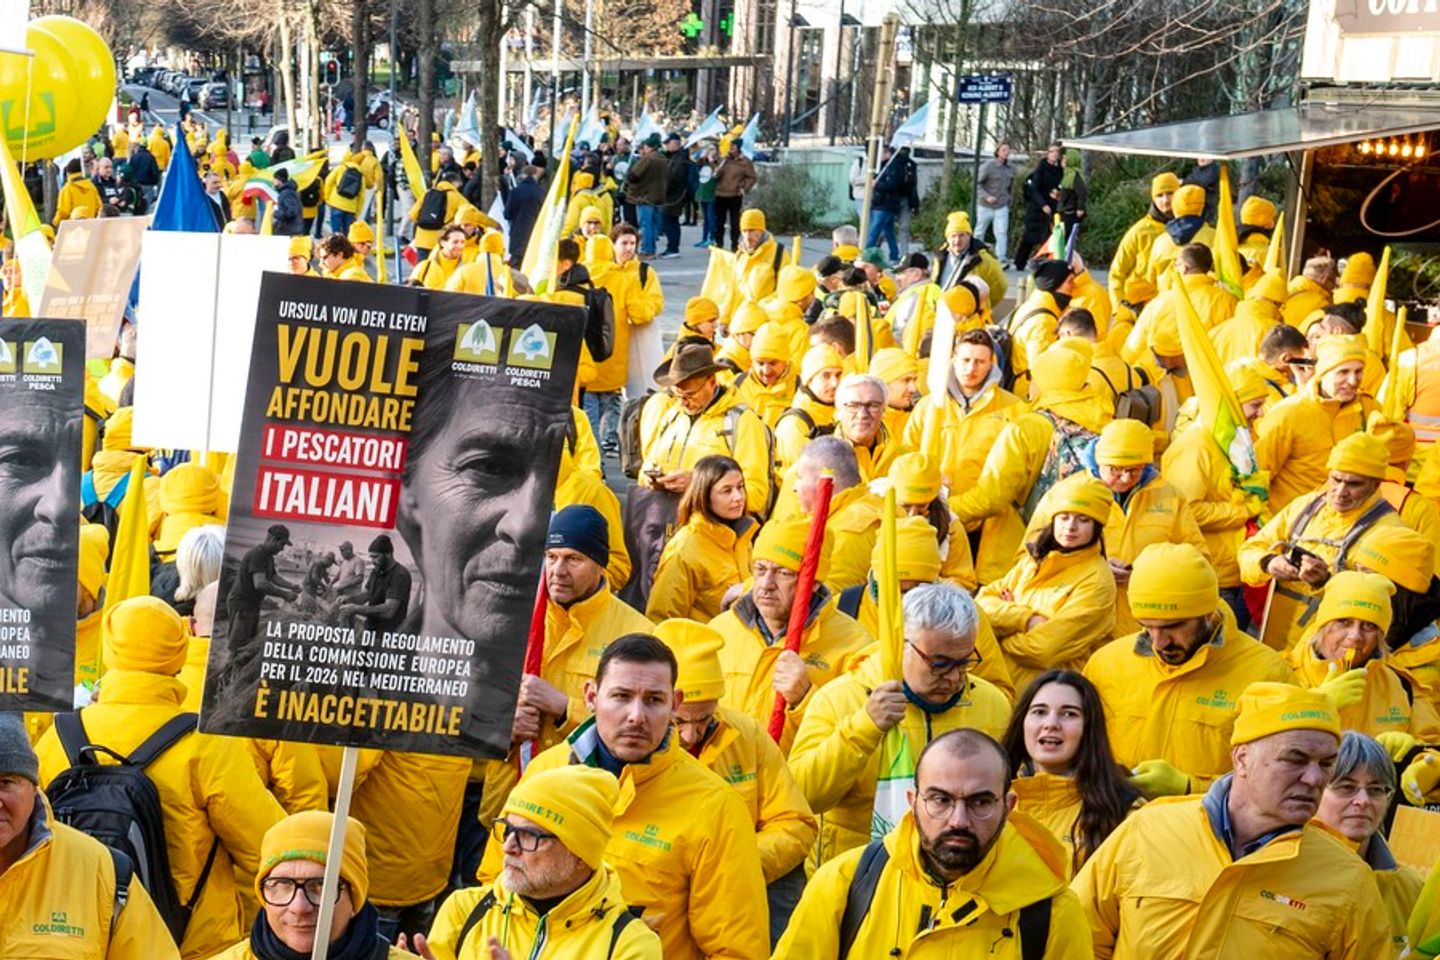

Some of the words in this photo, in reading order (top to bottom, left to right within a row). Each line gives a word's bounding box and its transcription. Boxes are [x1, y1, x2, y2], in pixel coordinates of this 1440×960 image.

[279, 300, 329, 323] URSULA
[331, 306, 358, 326] VON
[361, 309, 386, 329] DER
[389, 312, 428, 333] LEYEN
[276, 323, 426, 398] VUOLE
[451, 361, 498, 375] COLDIRETTI
[505, 366, 551, 380] COLDIRETTI
[22, 374, 62, 384] COLDIRETTI
[28, 382, 56, 391] PESCA
[510, 377, 541, 389] PESCA
[265, 385, 416, 431] AFFONDARE
[265, 428, 276, 456] I
[281, 429, 403, 470] PESCATORI
[259, 471, 393, 523] ITALIANI
[266, 621, 282, 638] LA
[288, 622, 356, 645] PROPOSTA
[361, 629, 376, 647] DI
[381, 631, 475, 657] REGOLAMENTO
[263, 641, 303, 661] DELLA
[309, 646, 407, 672] COMMISSIONE
[411, 655, 471, 678] EUROPEA
[260, 662, 286, 680] PER
[289, 664, 301, 682] IL
[305, 665, 338, 685] 2026
[341, 669, 366, 688] NEL
[369, 672, 469, 697] MEDITERRANEO
[254, 679, 271, 718] È
[277, 690, 465, 735] INACCETTABILE
[32, 924, 85, 936] COLDIRETTI
